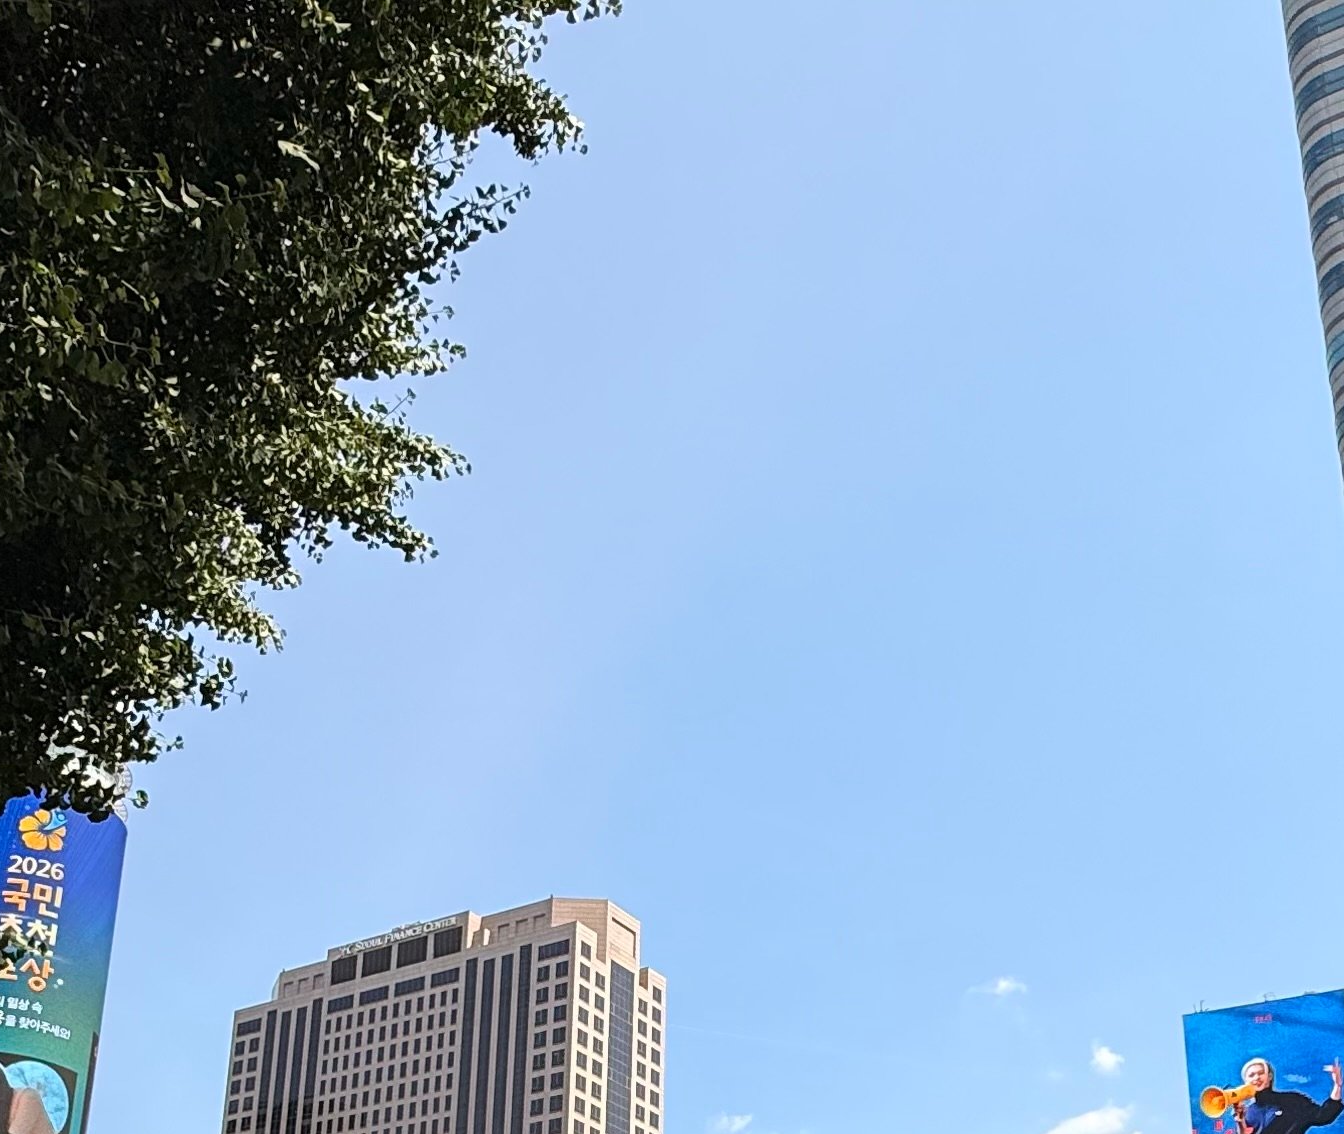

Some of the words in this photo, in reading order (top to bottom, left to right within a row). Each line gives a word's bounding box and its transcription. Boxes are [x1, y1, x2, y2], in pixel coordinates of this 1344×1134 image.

[7, 854, 65, 881] 2026
[1, 877, 64, 920] 국민
[6, 997, 30, 1011] 일상
[18, 1016, 71, 1040] 찾아주세요
